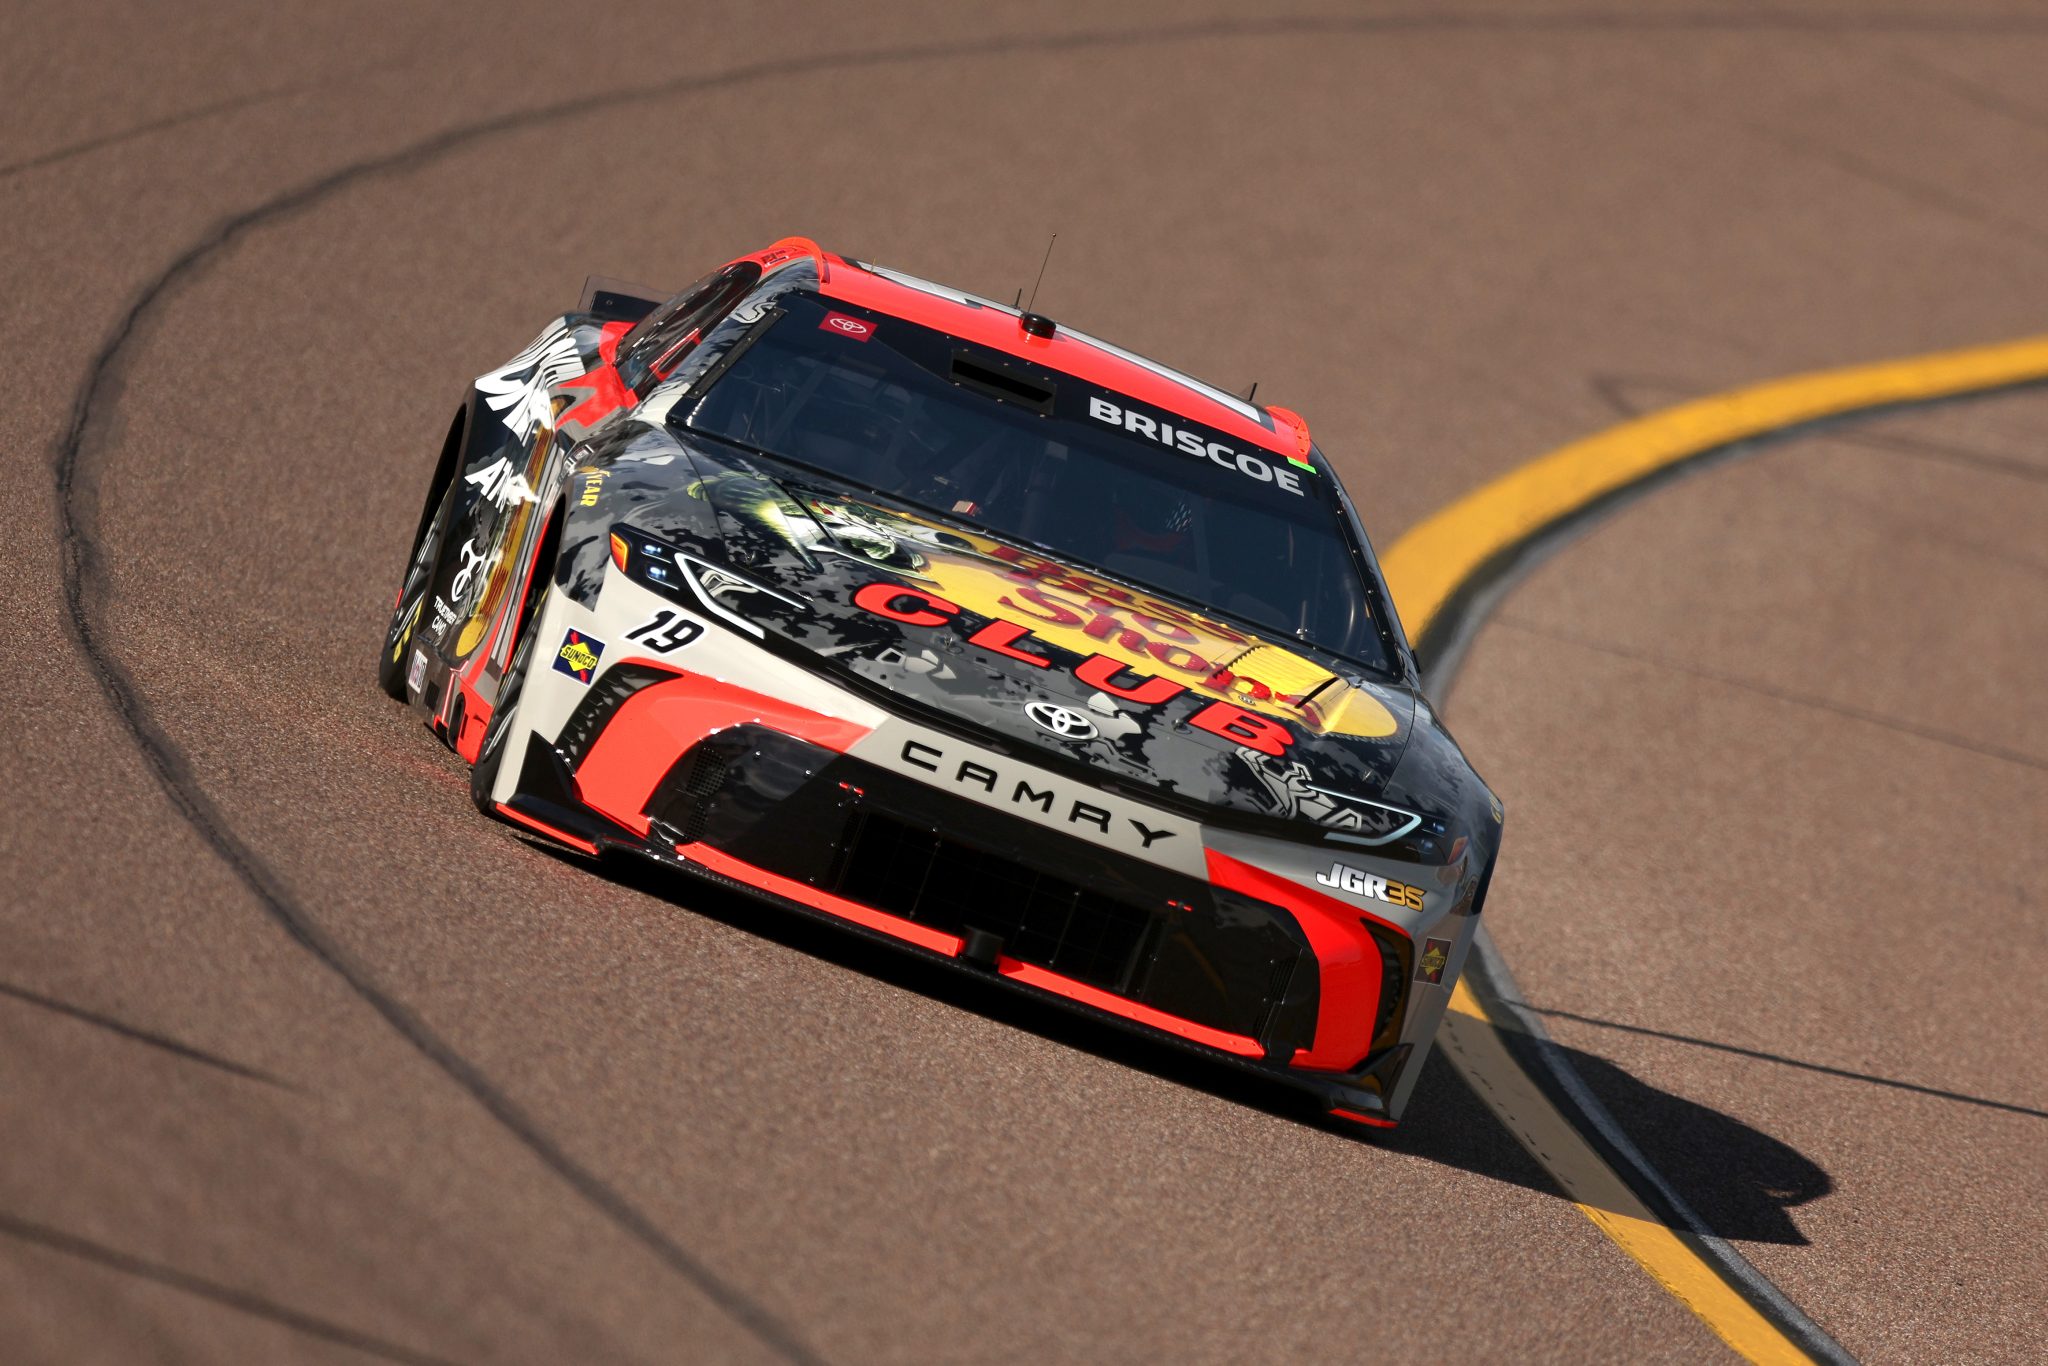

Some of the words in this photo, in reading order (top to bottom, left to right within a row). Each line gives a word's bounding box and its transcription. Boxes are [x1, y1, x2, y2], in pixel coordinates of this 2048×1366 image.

[1089, 396, 1304, 497] BRISCOE
[625, 610, 704, 654] 19
[984, 544, 1249, 645] Bass
[561, 646, 596, 667] SUNOCO
[854, 583, 1295, 757] CLUB
[900, 740, 1177, 848] CAMRY
